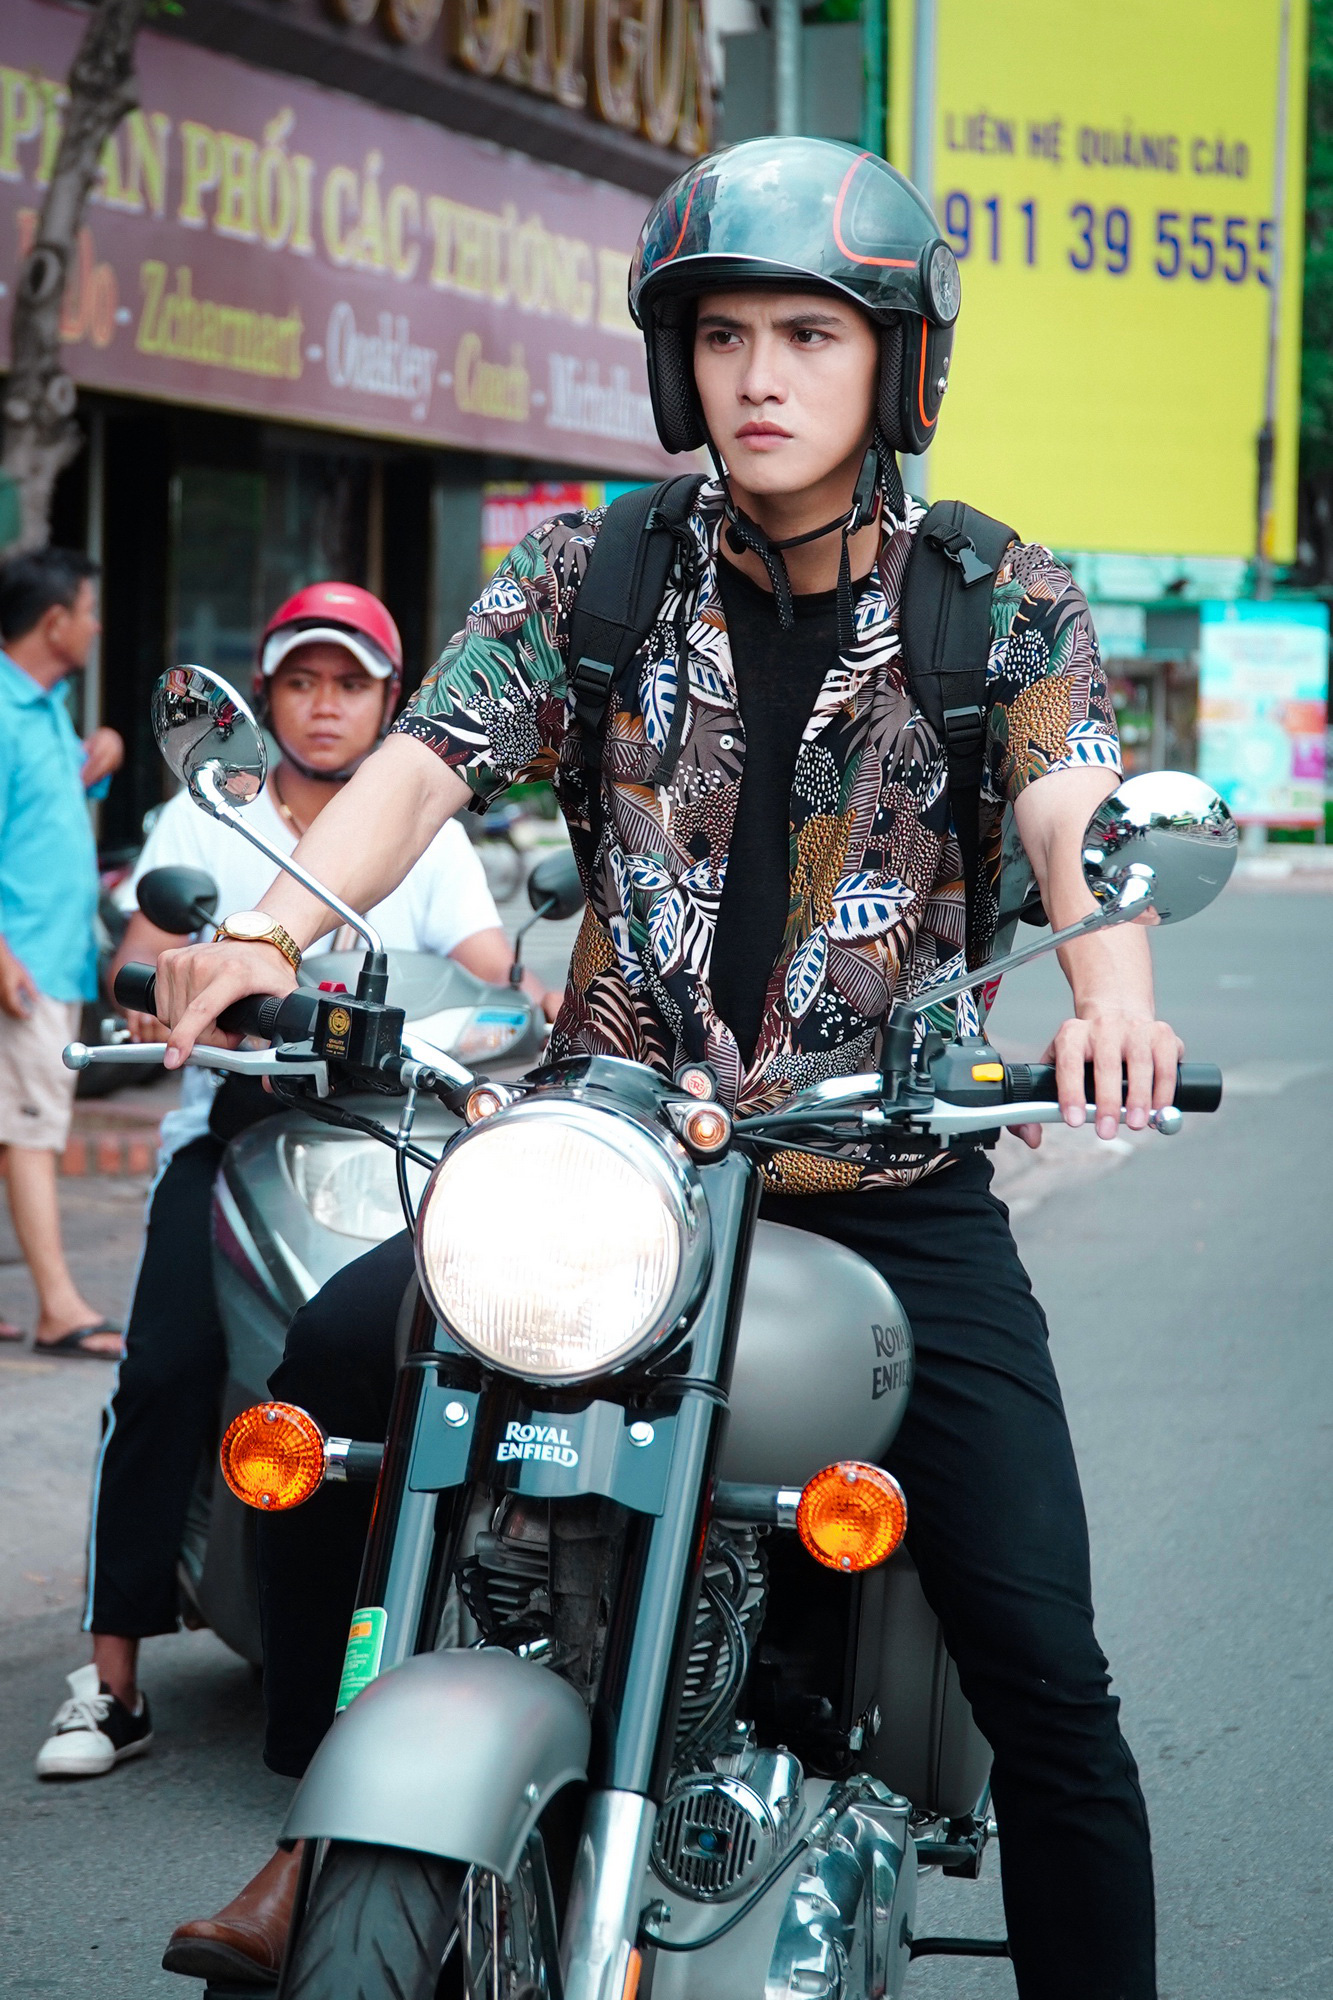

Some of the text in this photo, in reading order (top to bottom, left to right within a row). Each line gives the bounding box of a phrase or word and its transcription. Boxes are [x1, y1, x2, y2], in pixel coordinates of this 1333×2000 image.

[0, 64, 172, 217] PN
[944, 190, 1277, 287] 911 39 5555
[872, 1357, 912, 1400] ENFIE
[496, 1442, 579, 1468] ENFIELD
[505, 1421, 572, 1446] ROYAL
